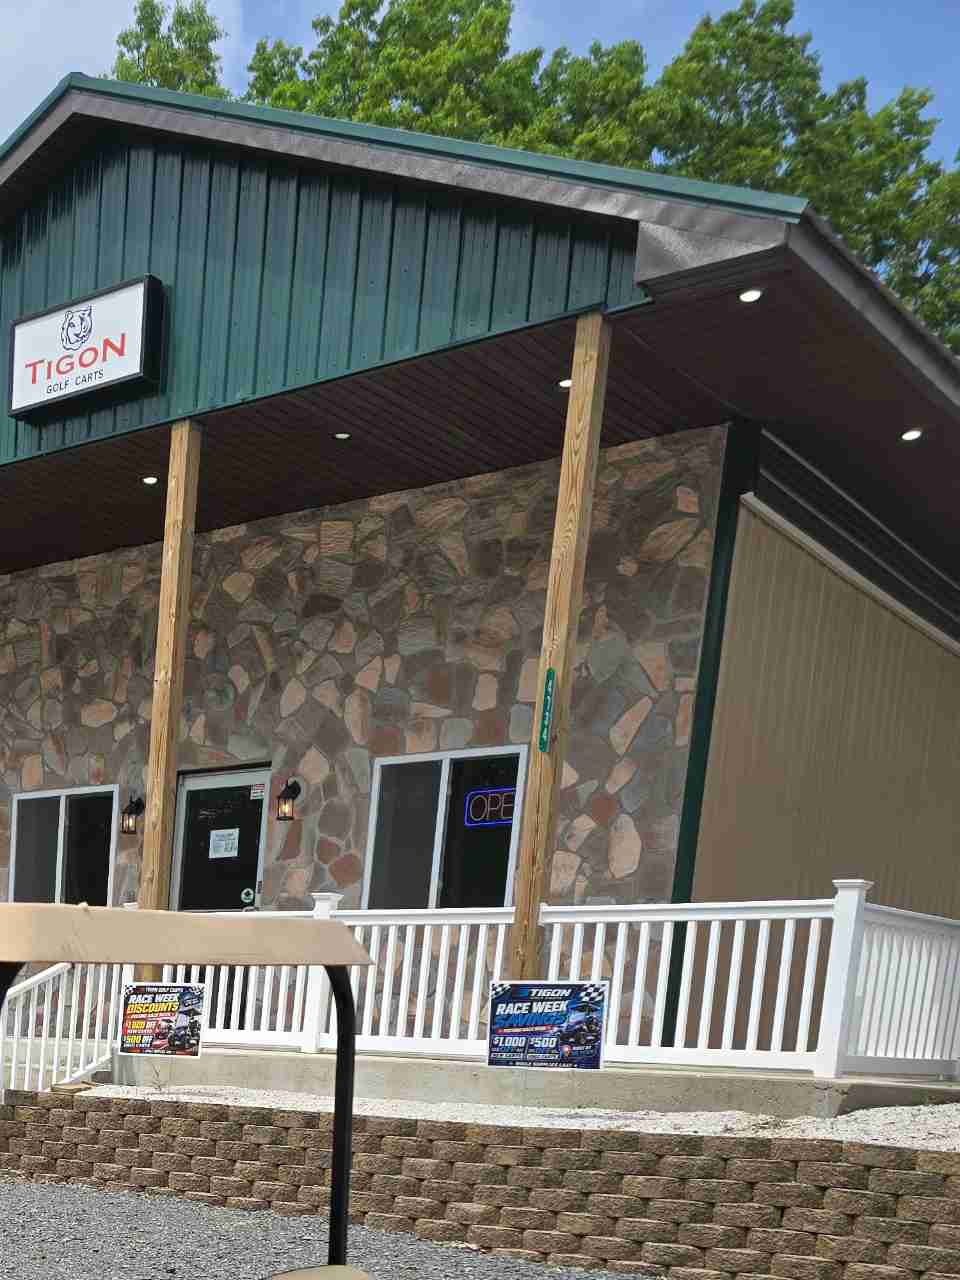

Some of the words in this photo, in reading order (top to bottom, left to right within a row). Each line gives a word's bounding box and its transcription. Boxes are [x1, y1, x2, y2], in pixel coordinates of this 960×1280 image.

[25, 333, 126, 384] TIGON
[46, 380, 70, 393] GOLF
[75, 369, 104, 385] CARTS
[470, 793, 514, 821] OPE
[128, 994, 155, 1004] RACE
[155, 993, 180, 1003] WEEK
[530, 989, 571, 997] TIGON
[127, 1002, 180, 1014] DISCOUNTS
[496, 1002, 531, 1015] RACE
[531, 1000, 569, 1013] WEEK
